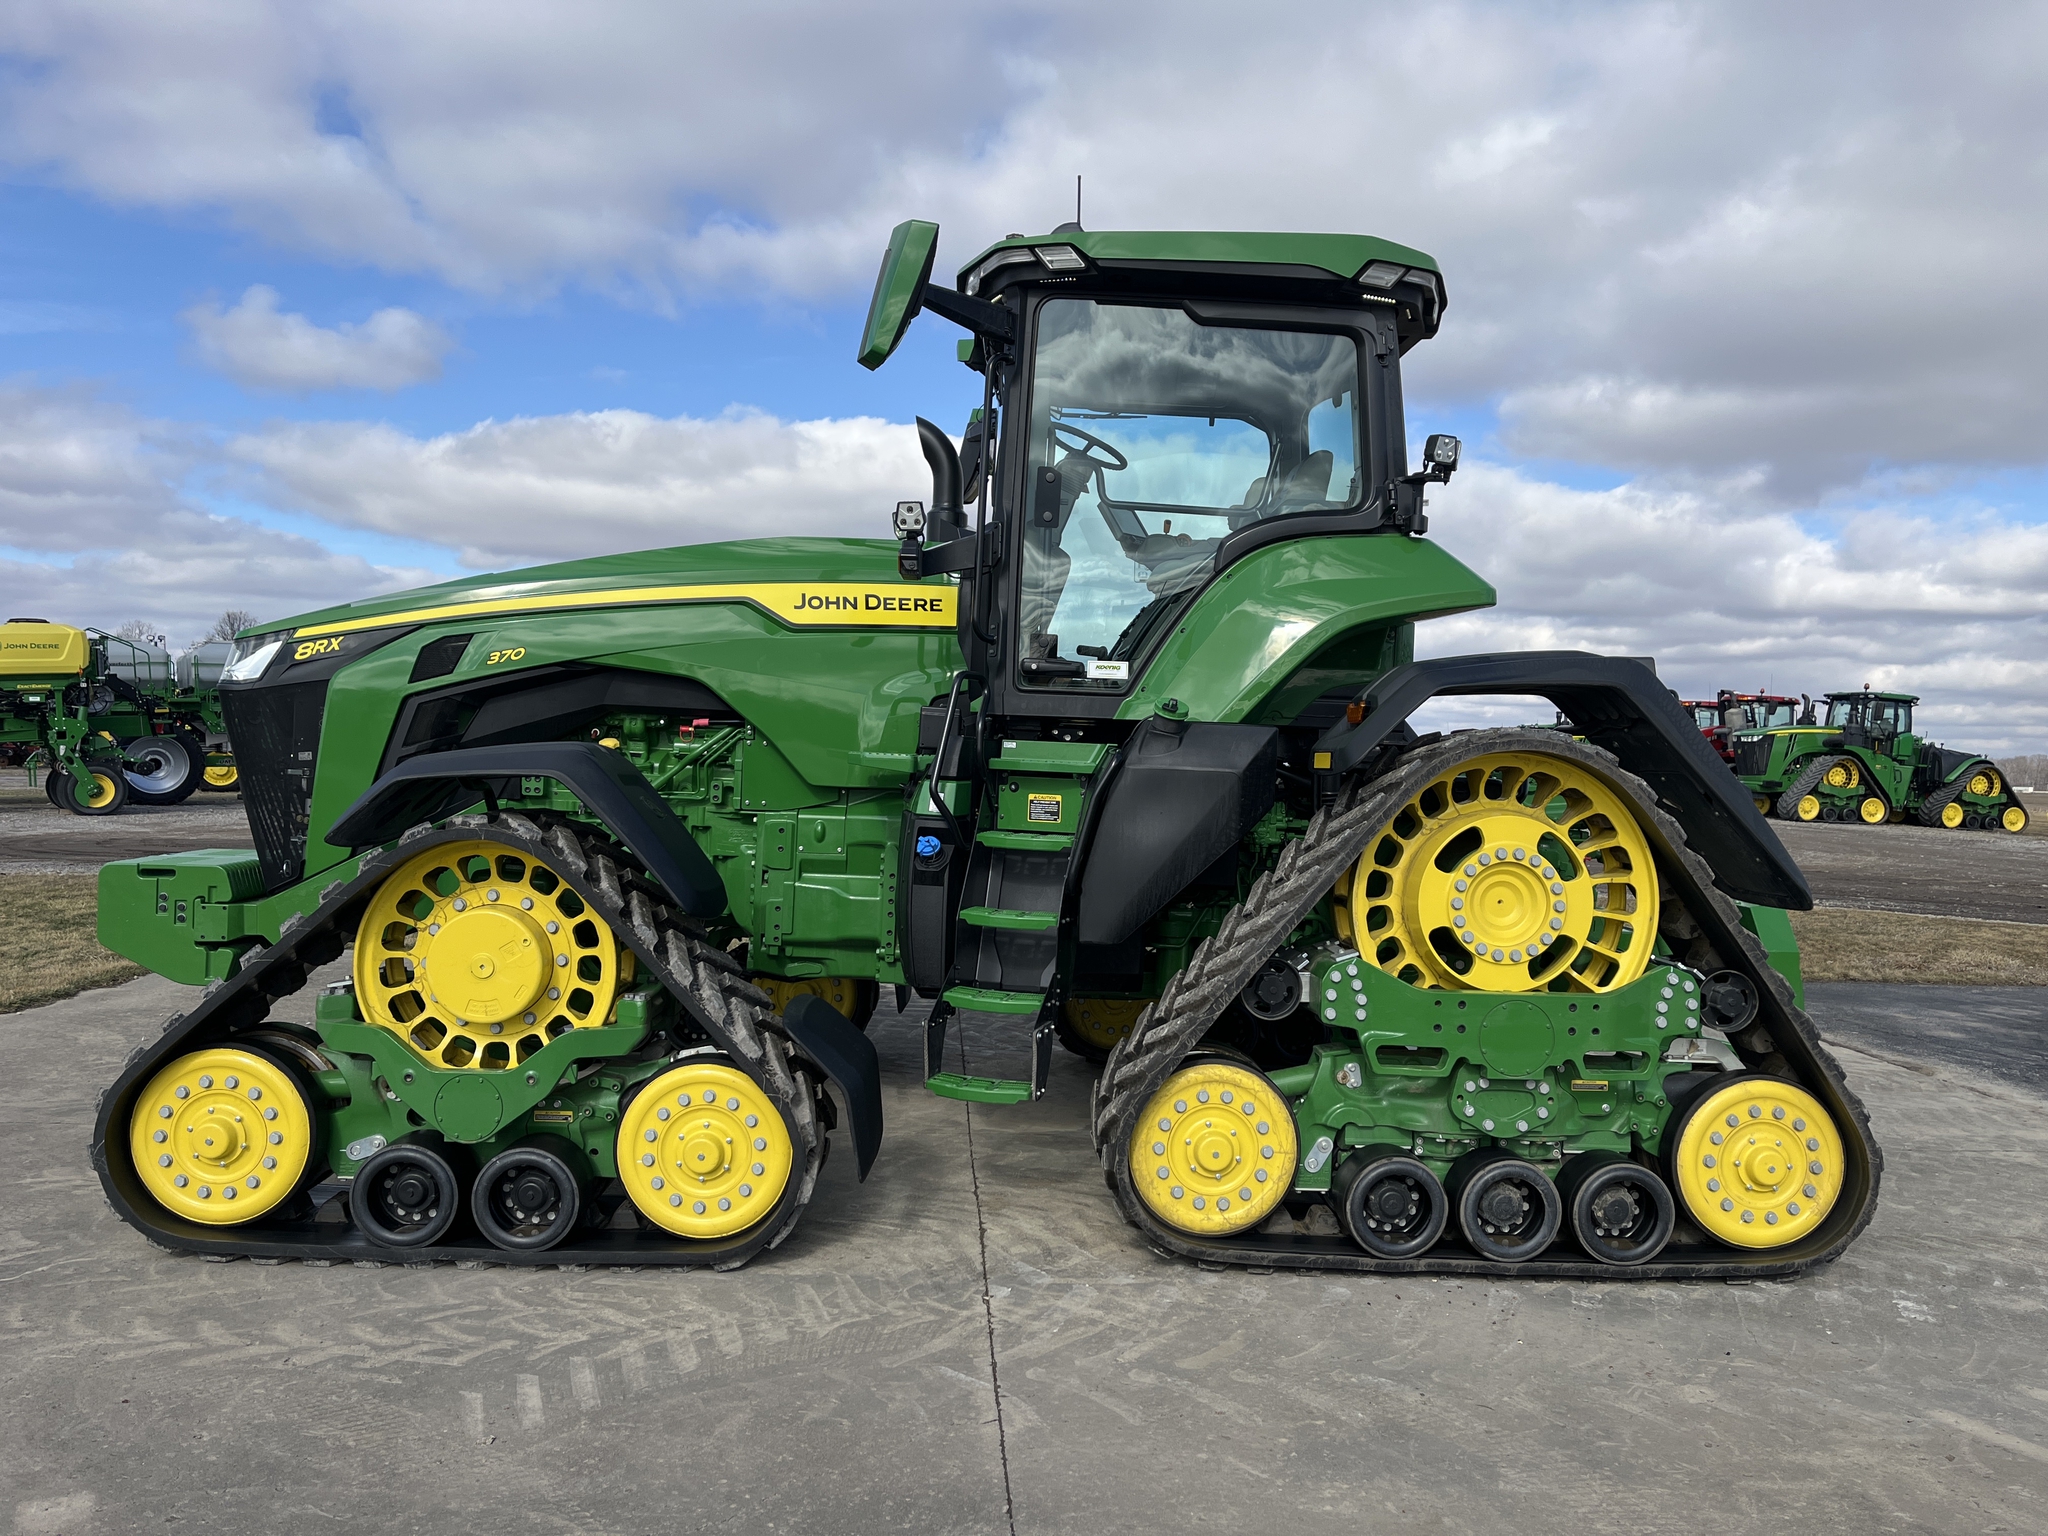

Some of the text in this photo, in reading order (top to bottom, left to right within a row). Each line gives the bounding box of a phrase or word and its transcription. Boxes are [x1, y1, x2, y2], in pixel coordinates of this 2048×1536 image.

[794, 593, 943, 612] JOHN DEERE
[294, 636, 345, 660] 8RX
[486, 647, 526, 665] 370
